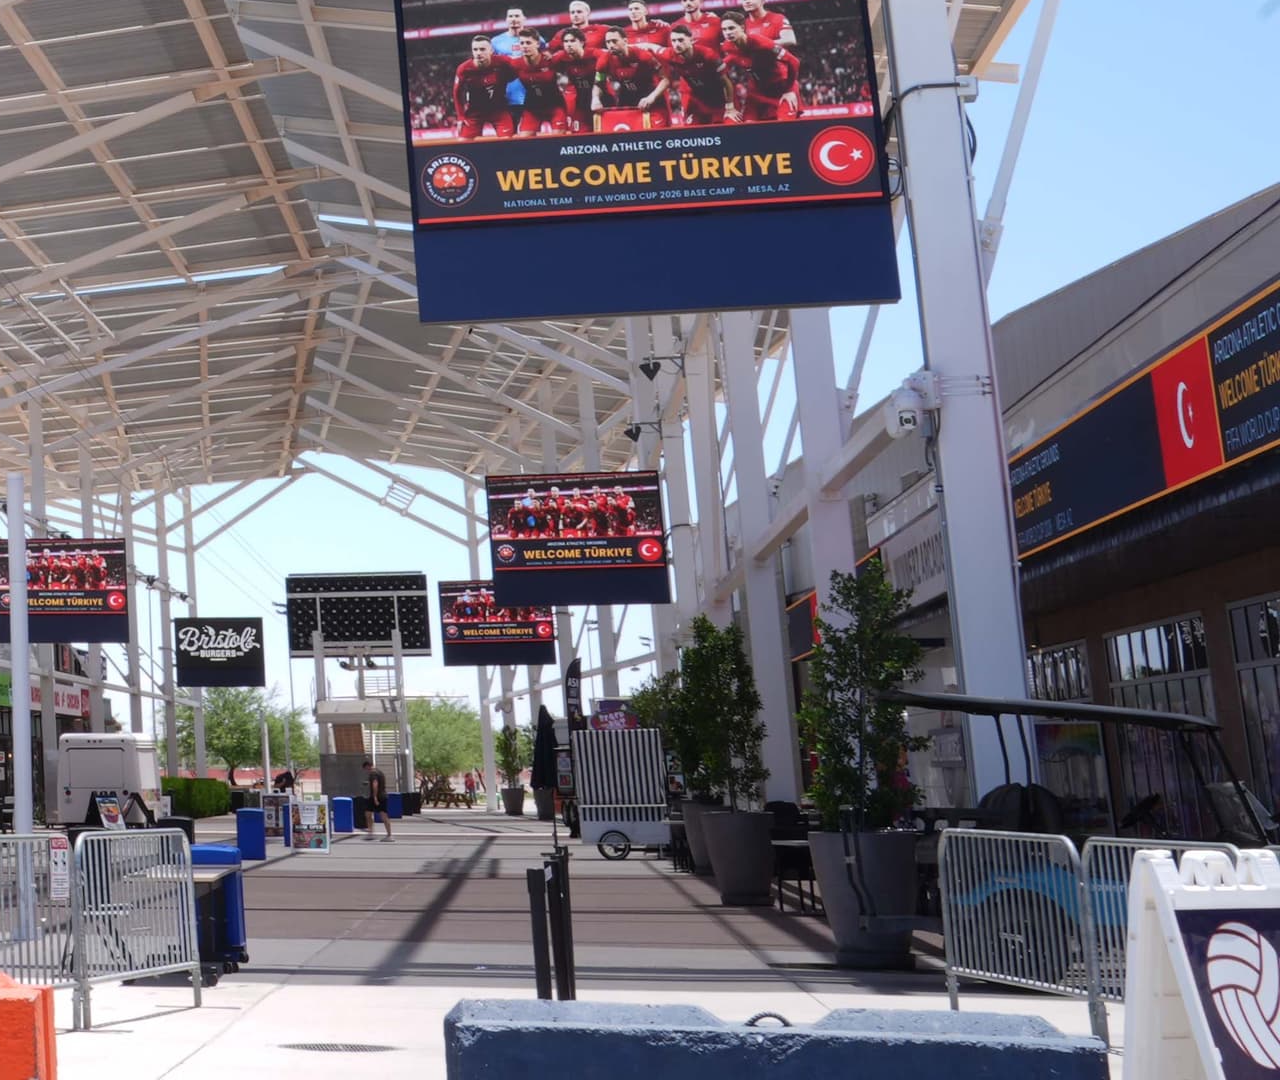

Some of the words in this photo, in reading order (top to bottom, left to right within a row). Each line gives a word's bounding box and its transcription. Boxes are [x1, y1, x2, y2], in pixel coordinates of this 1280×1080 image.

[560, 144, 608, 156] ARIZONA
[611, 140, 663, 153] ATHLETIC
[665, 136, 722, 149] GROUNDS
[427, 156, 470, 175] ARIZONA
[496, 161, 652, 192] WELCOME
[659, 153, 793, 183] TÜRKIYE
[503, 198, 546, 209] NATIONAL
[549, 196, 573, 206] TEAM
[584, 194, 605, 204] FIFA
[605, 192, 637, 203] WORLD
[639, 191, 658, 200] CUP
[660, 189, 682, 199] 2026
[684, 188, 707, 198] BASE
[709, 187, 736, 196] CAMP
[747, 185, 776, 194] MESA,
[777, 183, 790, 192] AZ
[1214, 327, 1244, 365] ARIZONA
[1218, 364, 1260, 410] WELCOME
[1241, 414, 1266, 445] WORLD
[523, 549, 582, 560] WELCOME
[584, 546, 633, 558] TÜRKIYE
[66, 597, 104, 607] TÜRKIYE
[178, 625, 260, 652] Bristol's
[463, 628, 500, 636] WELCOME
[200, 649, 237, 658] BURGERS
